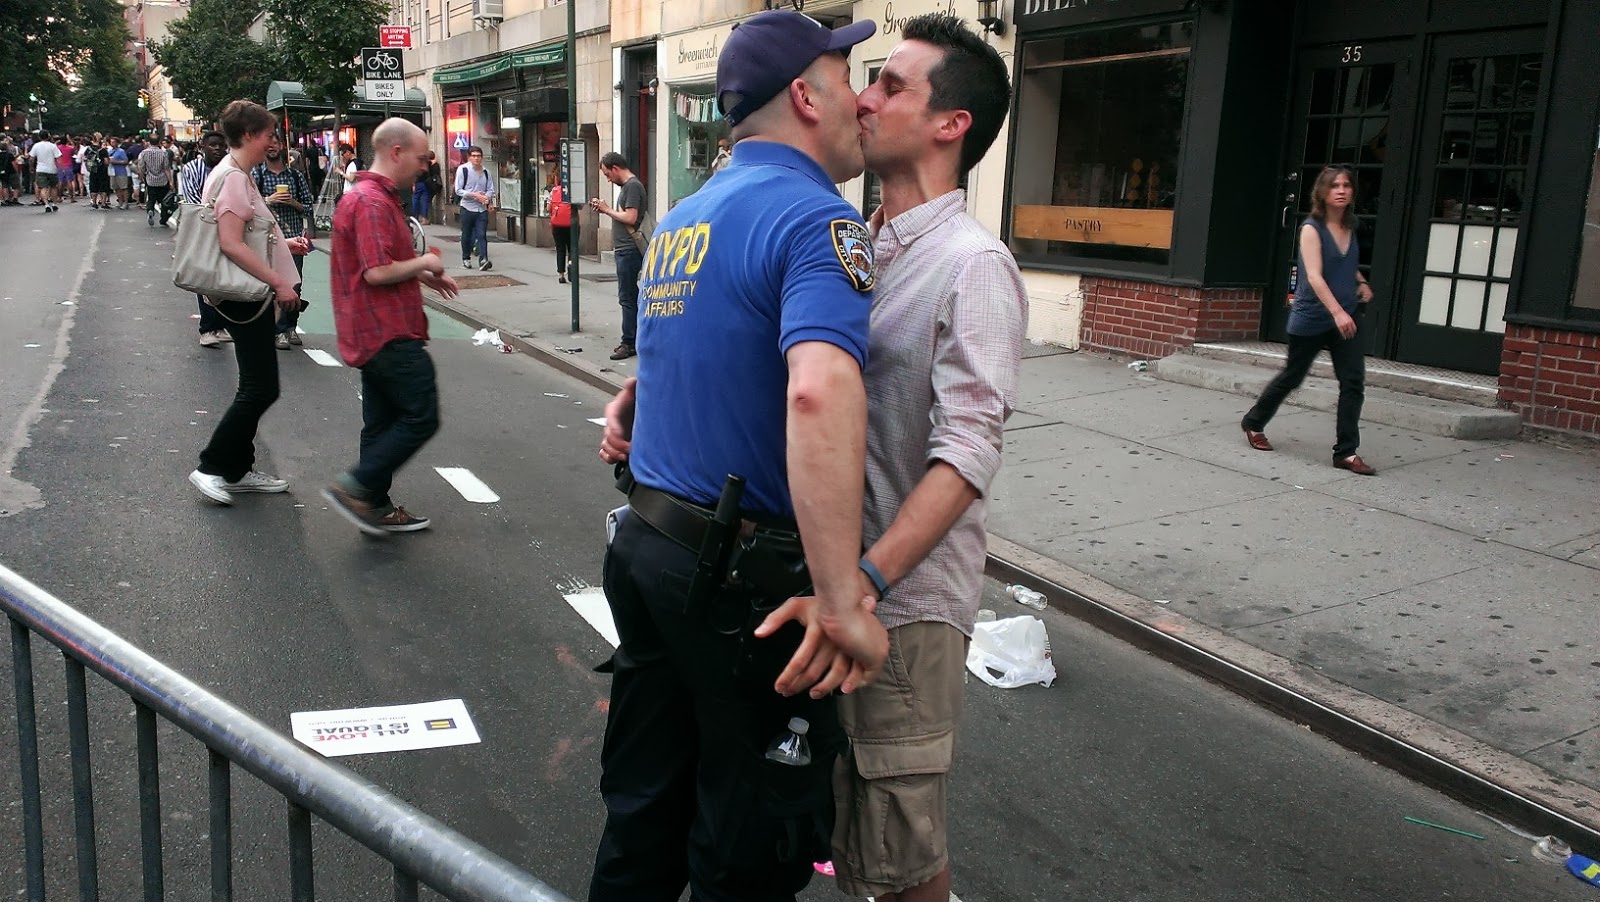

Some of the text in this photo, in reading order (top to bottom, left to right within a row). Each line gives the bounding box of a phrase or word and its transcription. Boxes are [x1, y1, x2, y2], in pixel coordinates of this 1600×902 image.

[678, 34, 718, 64] Greenwich
[1342, 46, 1362, 63] 35
[383, 71, 402, 79] LANE
[1064, 218, 1102, 231] PASTRY
[641, 222, 711, 283] NYPD
[838, 245, 851, 264] CITY
[849, 264, 858, 276] OF
[642, 280, 697, 300] COMMUNITY
[644, 300, 685, 318] AFFAIRS
[312, 722, 409, 735] IS EQUAL
[312, 728, 410, 742] ALL LOVE
